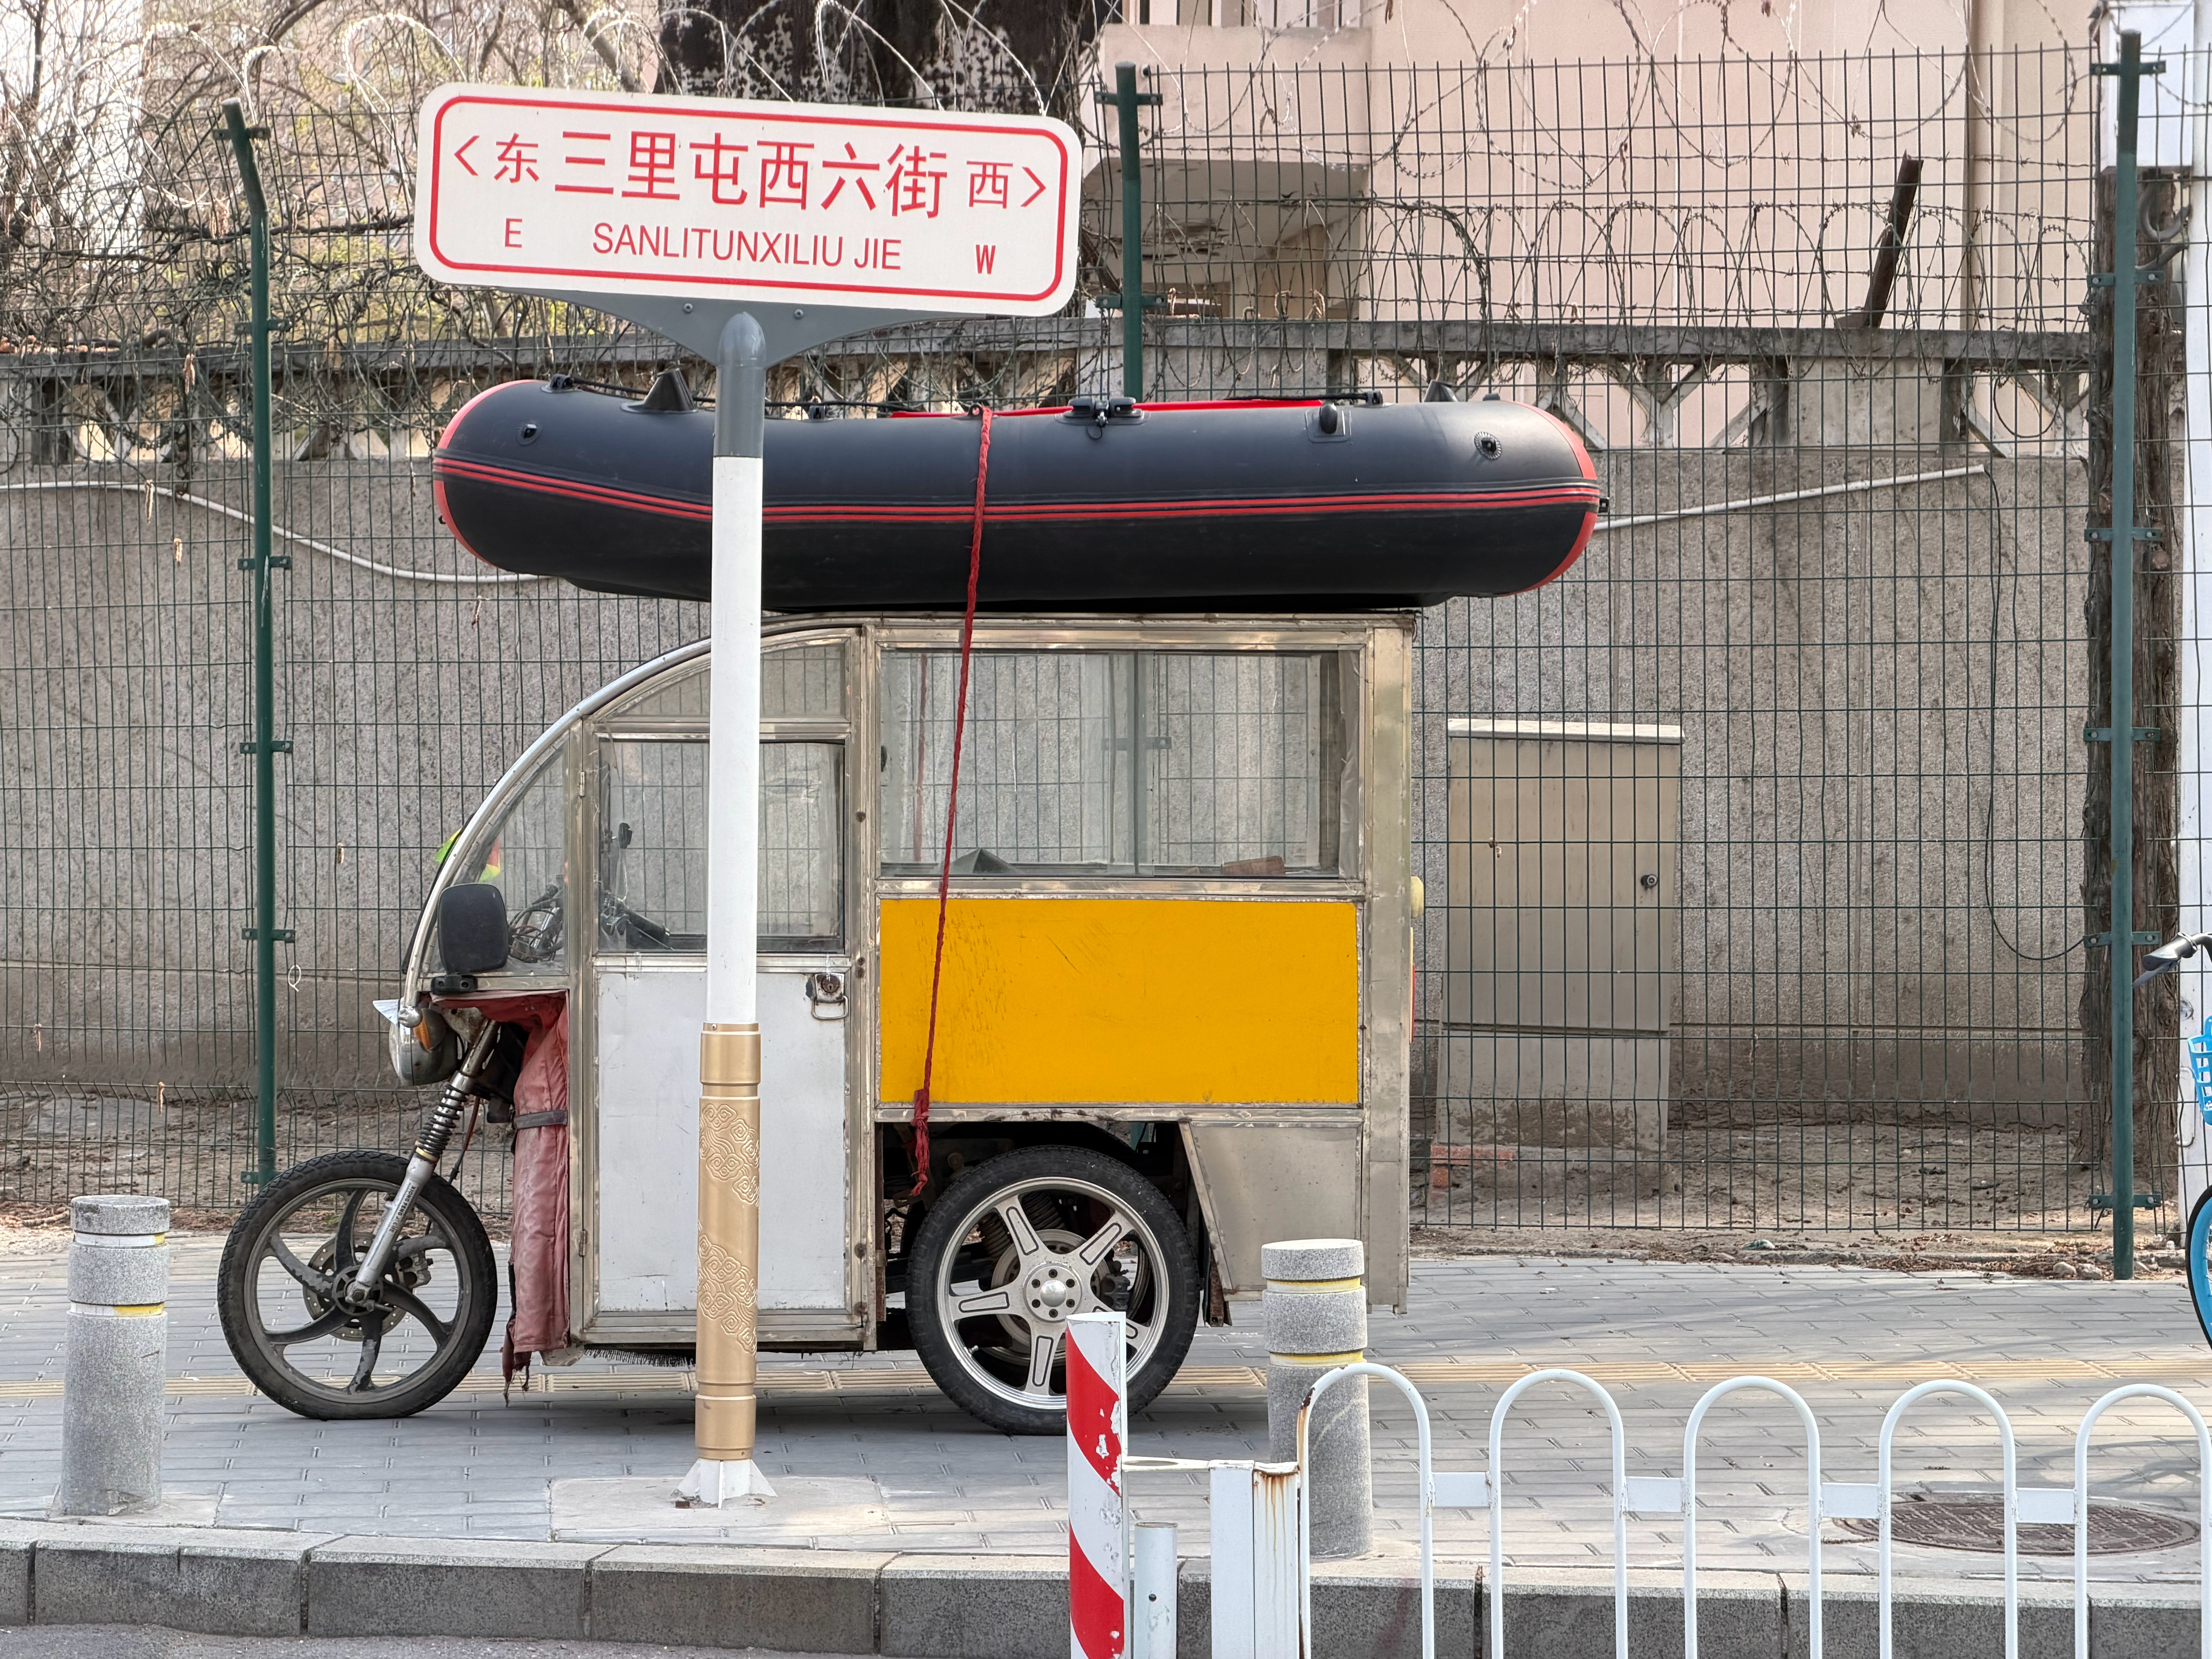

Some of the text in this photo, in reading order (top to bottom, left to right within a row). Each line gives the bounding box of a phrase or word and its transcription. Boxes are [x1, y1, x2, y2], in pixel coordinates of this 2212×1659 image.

[494, 131, 1013, 219] 东 三里屯西六街 西
[505, 218, 996, 275] E SANLITUNXILIU JIE W
[398, 1202, 407, 1216] FENG
[405, 1185, 416, 1202] XIONG
